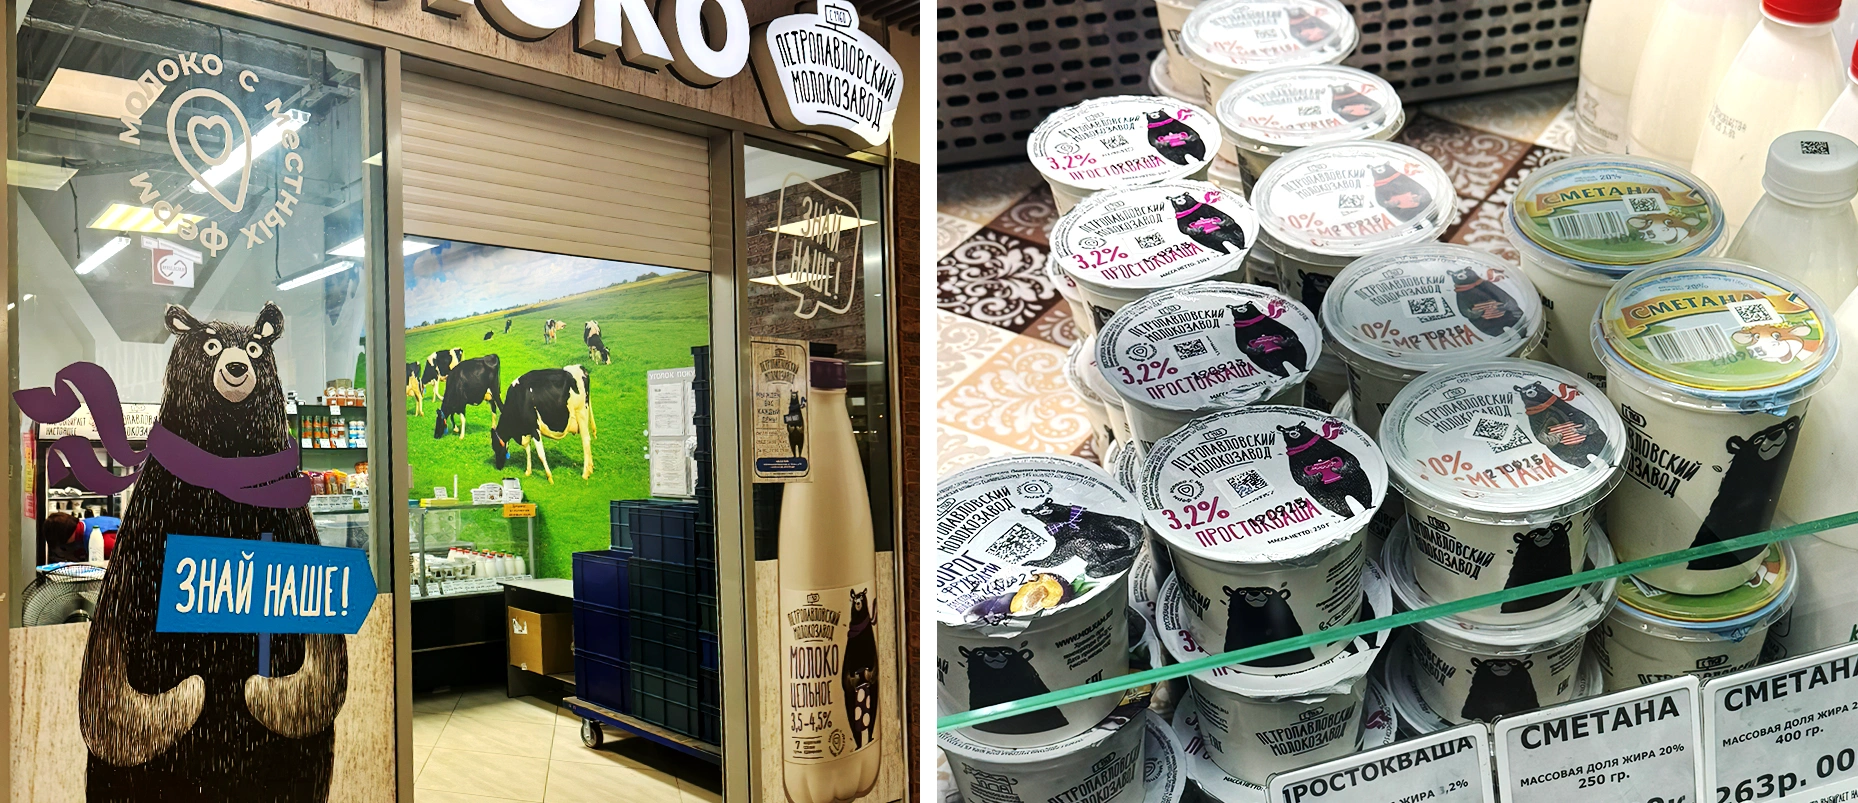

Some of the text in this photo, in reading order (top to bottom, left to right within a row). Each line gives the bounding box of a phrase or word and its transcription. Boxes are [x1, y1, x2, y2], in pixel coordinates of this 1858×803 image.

[775, 29, 897, 102] ПЕТРОПАВЛОВСКИЙ
[791, 70, 883, 132] МОЛОКОЗАВОД
[1047, 152, 1097, 171] 3,2%
[800, 196, 843, 253] ЗНАЙ
[790, 238, 842, 300] НАШЕ!
[1072, 246, 1129, 270] 3,2%
[1128, 308, 1225, 338] ПЕТРОПАВЛОВСКИЙ
[1144, 318, 1221, 344] МОЛОКОЗАВОД
[648, 372, 674, 380] УГОЛОК
[1117, 357, 1178, 385] 3,2%
[1415, 392, 1514, 427] ПЕТРОПАВЛОВСКИЙ
[1170, 431, 1276, 471] ПЕТРОПАВЛОВСКИЙ
[1189, 446, 1272, 478] МОЛОКОЗАВОД
[937, 497, 1016, 555] МОЛОКОЗАВОД
[1161, 496, 1230, 530] 3,2%
[1195, 498, 1322, 547] ПРОСТОКВАША
[176, 551, 350, 617] ЗНАЙ НАШЕ!
[787, 607, 841, 627] ПЕТРОПАВЛОВСКИЙ
[793, 624, 835, 641] МОЛОКОЗАВОД
[790, 644, 839, 679] МОЛОКО
[790, 680, 833, 711] ЦЕЛЬНОЕ
[1270, 722, 1347, 757] МОЛОКОЗАВОД
[1520, 695, 1680, 750] СМЕТАНА
[1722, 723, 1781, 747] МАССОВАЯ
[1784, 715, 1814, 731] ДОЛЯ
[1817, 705, 1849, 720] ЖИРА
[1775, 726, 1824, 744] 400 гр.
[1520, 743, 1685, 787] МАССОВАЯ ДОЛЯ ЖИРА 20%
[1578, 771, 1630, 789] 250 гр.
[1816, 748, 1855, 779] 00
[1438, 779, 1469, 795] 3,2%
